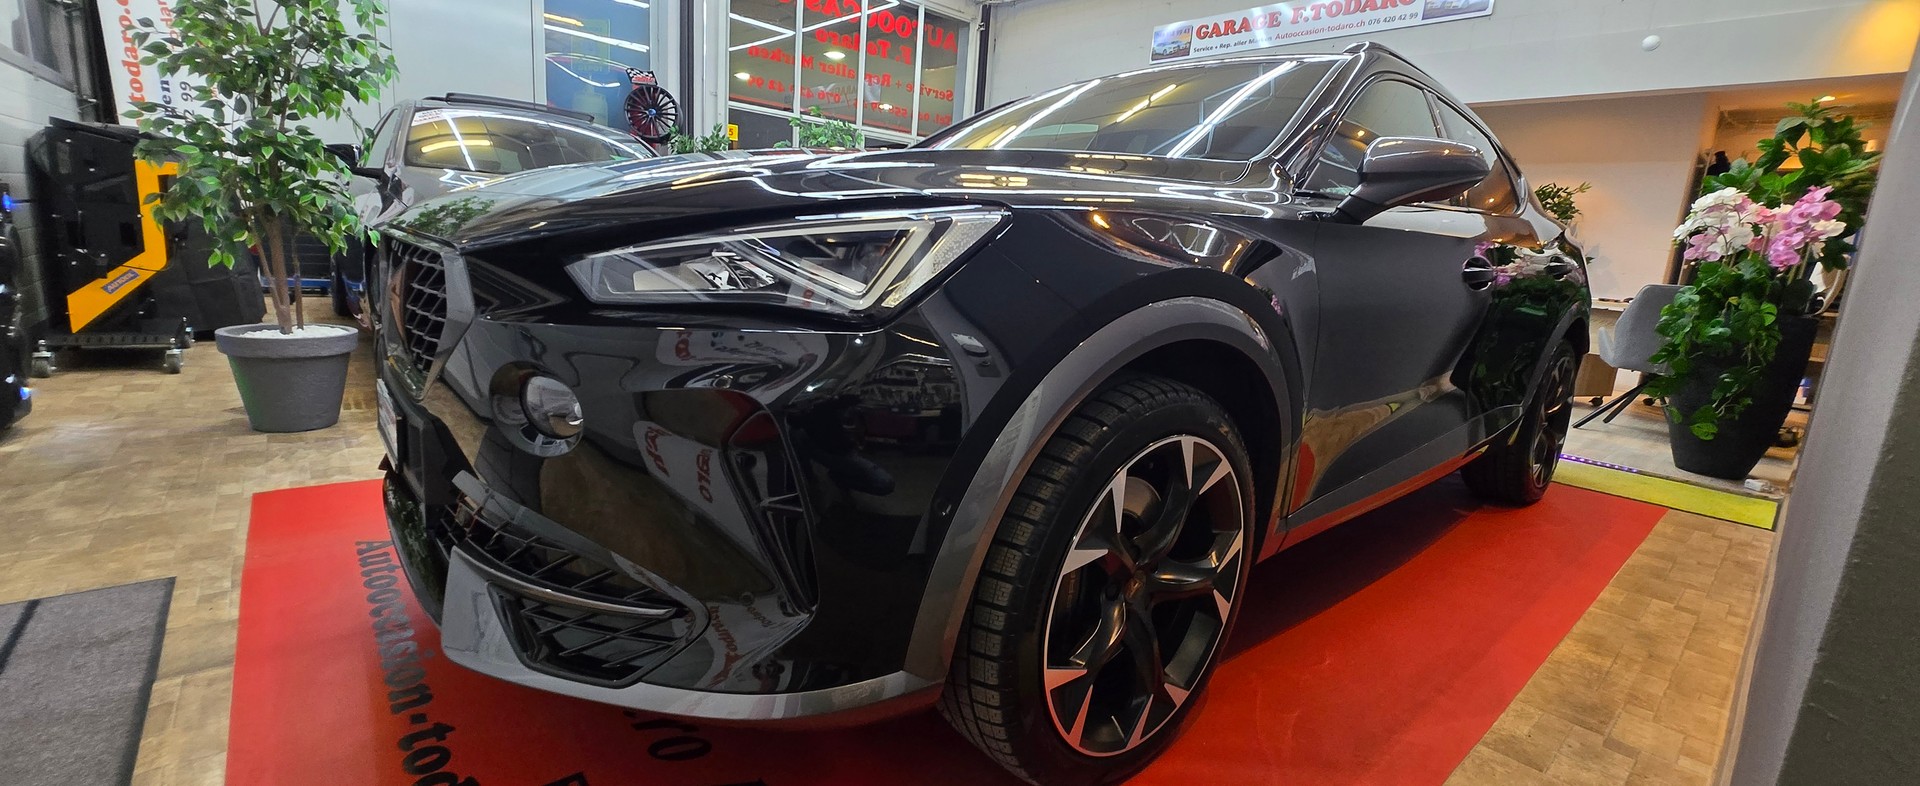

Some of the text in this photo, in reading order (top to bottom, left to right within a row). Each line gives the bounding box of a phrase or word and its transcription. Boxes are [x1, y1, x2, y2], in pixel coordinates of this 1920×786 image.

[1193, 44, 1213, 53] Service
[1219, 42, 1233, 50] Rep.
[1233, 39, 1247, 47] aller
[1249, 36, 1273, 45] Man
[1274, 19, 1366, 40] Autooccasion-todaro.ch
[1367, 18, 1380, 26] 076
[1382, 15, 1396, 23] 420
[1397, 13, 1407, 21] 42
[1408, 11, 1419, 19] 99
[1195, 11, 1282, 41] GARAGE
[117, 0, 146, 125] todaro.
[179, 81, 194, 102] 99
[623, 711, 712, 761] ro
